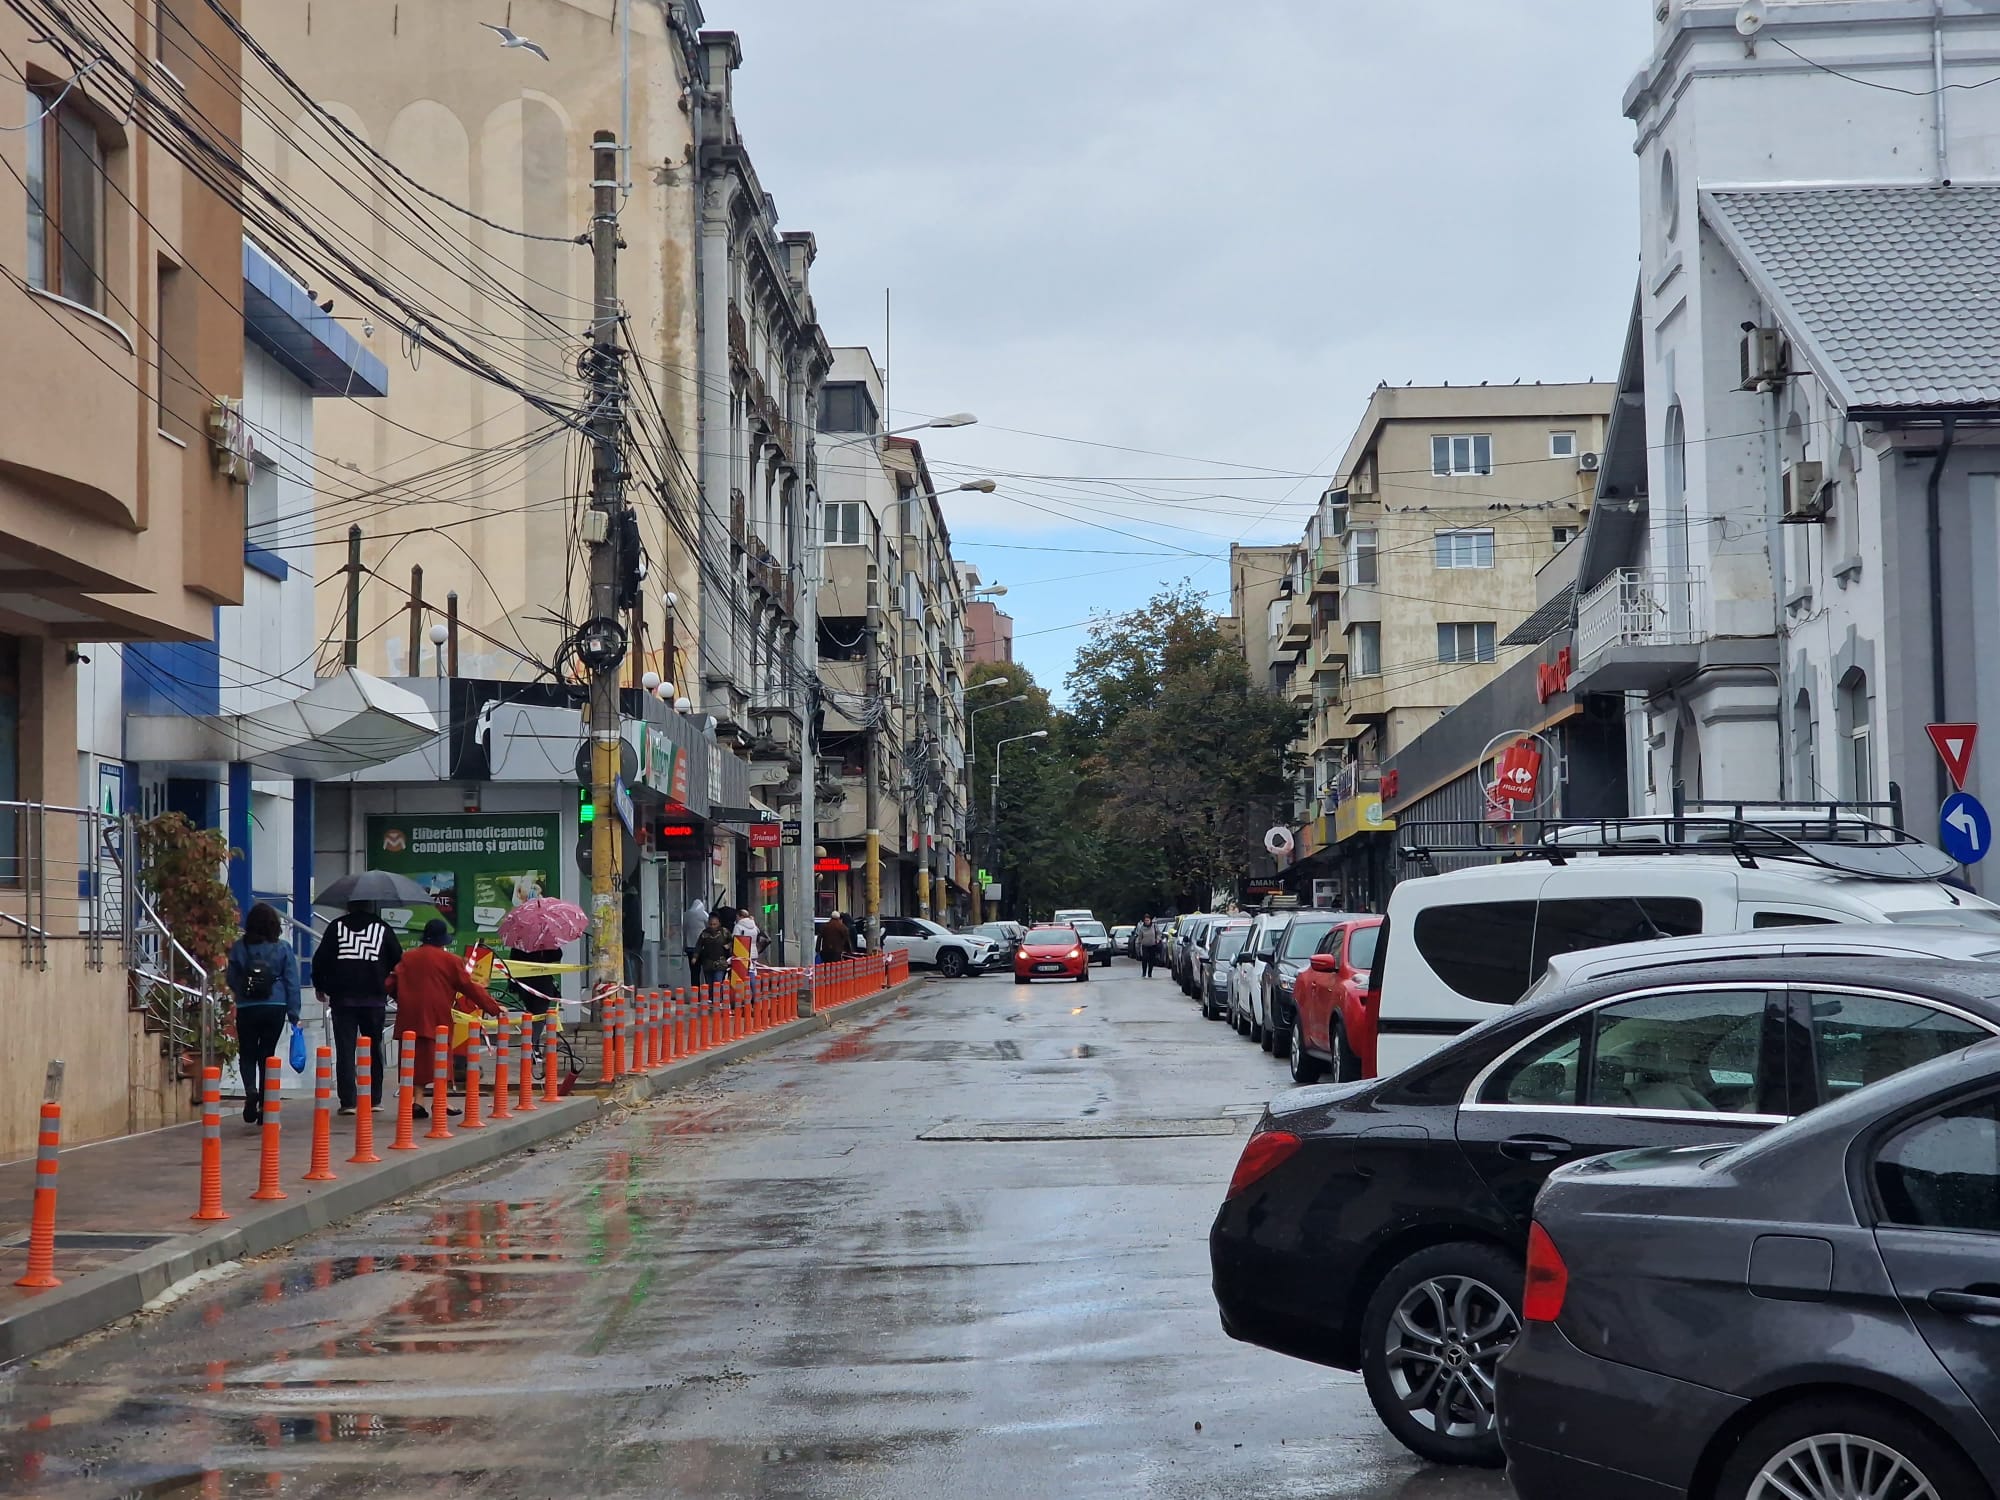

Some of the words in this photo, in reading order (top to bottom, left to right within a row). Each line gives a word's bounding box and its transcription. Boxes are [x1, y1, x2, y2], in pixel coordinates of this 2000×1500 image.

[1503, 784, 1532, 794] market
[412, 827, 463, 840] Eliberăm
[464, 826, 544, 839] medicamente
[752, 834, 778, 842] Triumph
[412, 841, 484, 854] compensate
[485, 840, 497, 855] și
[498, 838, 545, 853] gratuite
